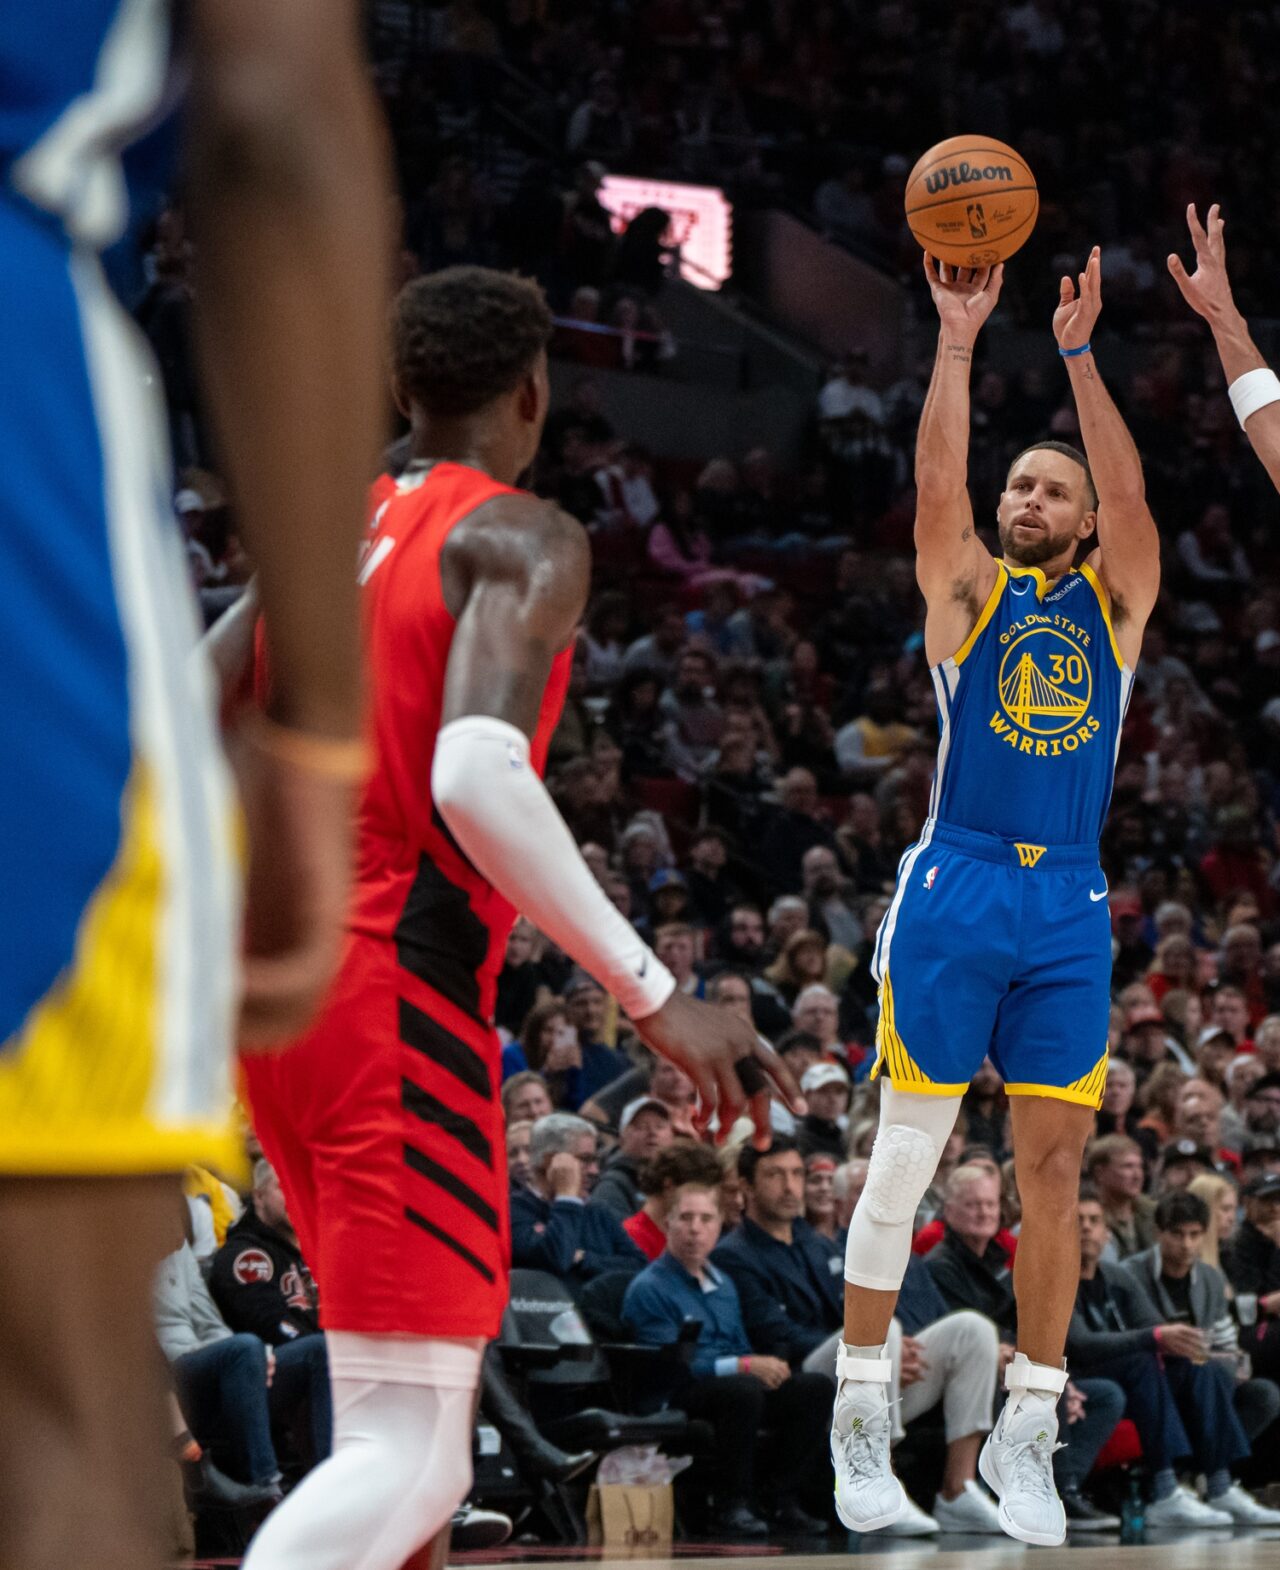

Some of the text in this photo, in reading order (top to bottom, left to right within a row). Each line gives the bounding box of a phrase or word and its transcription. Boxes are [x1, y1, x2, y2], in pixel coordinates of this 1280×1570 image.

[924, 162, 1013, 194] Wilson
[1045, 577, 1083, 603] Rakuten
[999, 614, 1092, 648] GOLDEN STATE
[1048, 654, 1084, 686] 30
[988, 710, 1101, 757] WARRIORS
